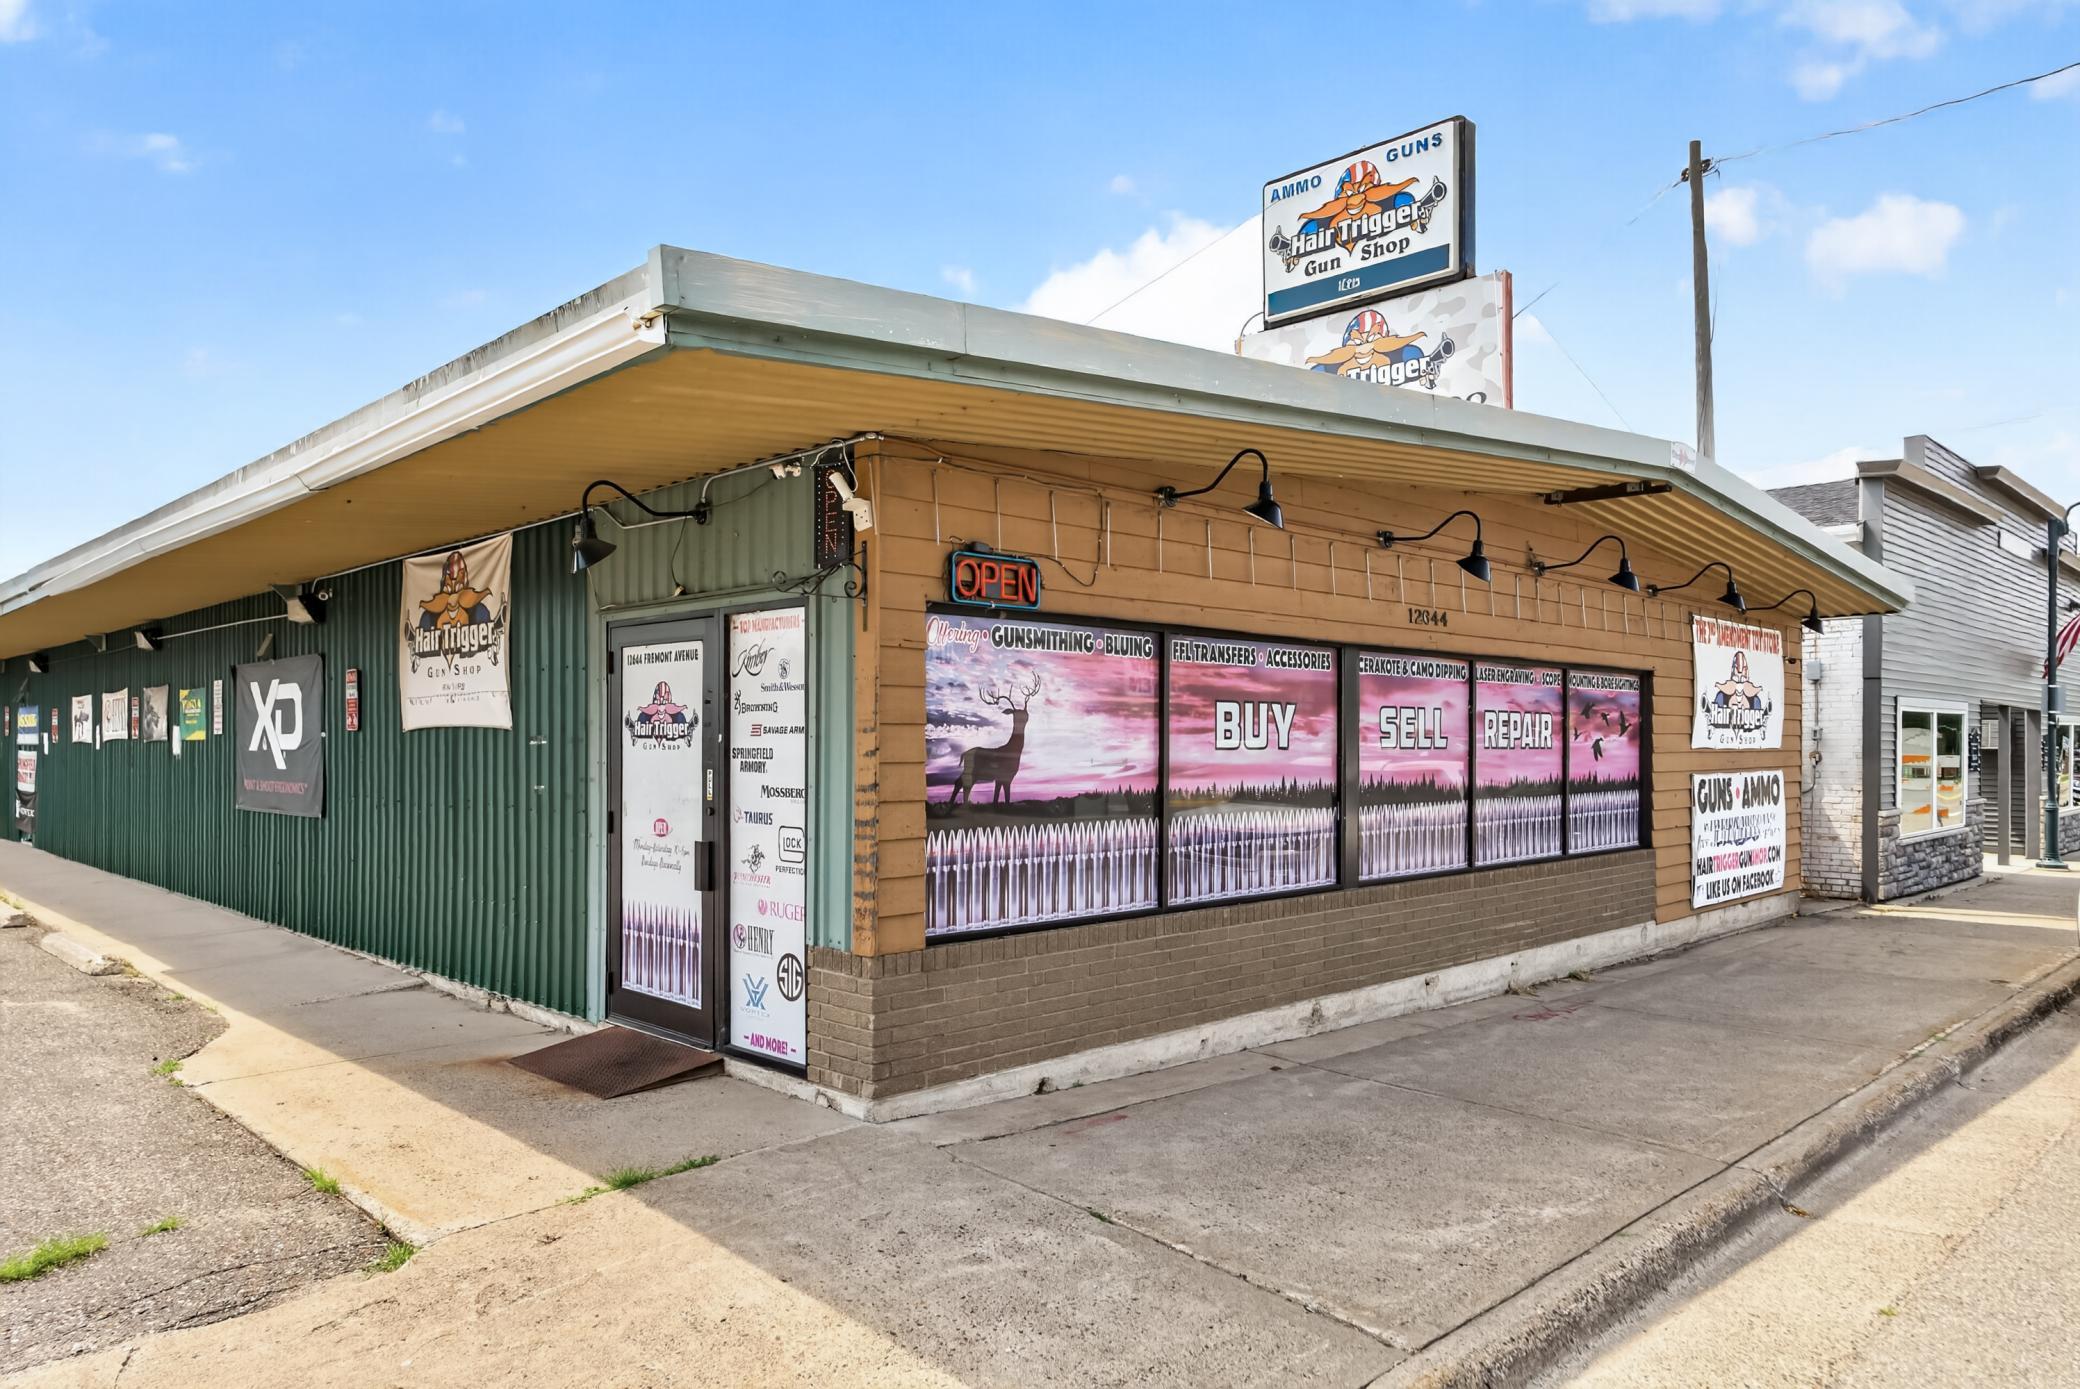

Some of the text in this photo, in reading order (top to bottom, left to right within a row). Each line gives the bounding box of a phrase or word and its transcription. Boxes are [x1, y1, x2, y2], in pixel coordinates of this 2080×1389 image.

[1386, 133, 1442, 162] GUNS
[1271, 175, 1322, 203] AMMO
[1290, 202, 1422, 258] Hair Trigger
[1304, 237, 1410, 276] Gun Shop
[956, 559, 1037, 603] OPEN
[1408, 607, 1448, 627] 12644
[415, 621, 495, 653] Hair Trigger
[991, 625, 1095, 655] GUNSMITHING
[1104, 633, 1153, 659] BLUING
[454, 664, 482, 675] SHOP
[644, 651, 672, 664] FREMONT
[674, 649, 698, 662] AVENUE
[1172, 640, 1332, 671] FFL TRANSFERS ACCESSORIES
[1359, 656, 1467, 681] CERAKOTE & CAMO DIPPING
[1476, 666, 1561, 687] LASER ENGRAVING SCOPE
[742, 701, 778, 714] BROWNING
[1711, 703, 1764, 729] Hair Trigger
[634, 720, 689, 739] Hair Trigger
[763, 726, 788, 735] SAVAGE
[1215, 700, 1296, 750] BUY
[1379, 706, 1448, 750] SELL
[1484, 710, 1552, 750] REPAIR
[732, 747, 774, 760] SPRINGFIELD
[1697, 774, 1780, 814] GUNS AMMO
[744, 811, 773, 825] TAURUS
[1706, 869, 1775, 900] LIKE US ON FACEBOOK
[748, 925, 775, 955] HENRY
[778, 954, 803, 1000] SIG
[750, 1032, 788, 1056] AND MORE!
